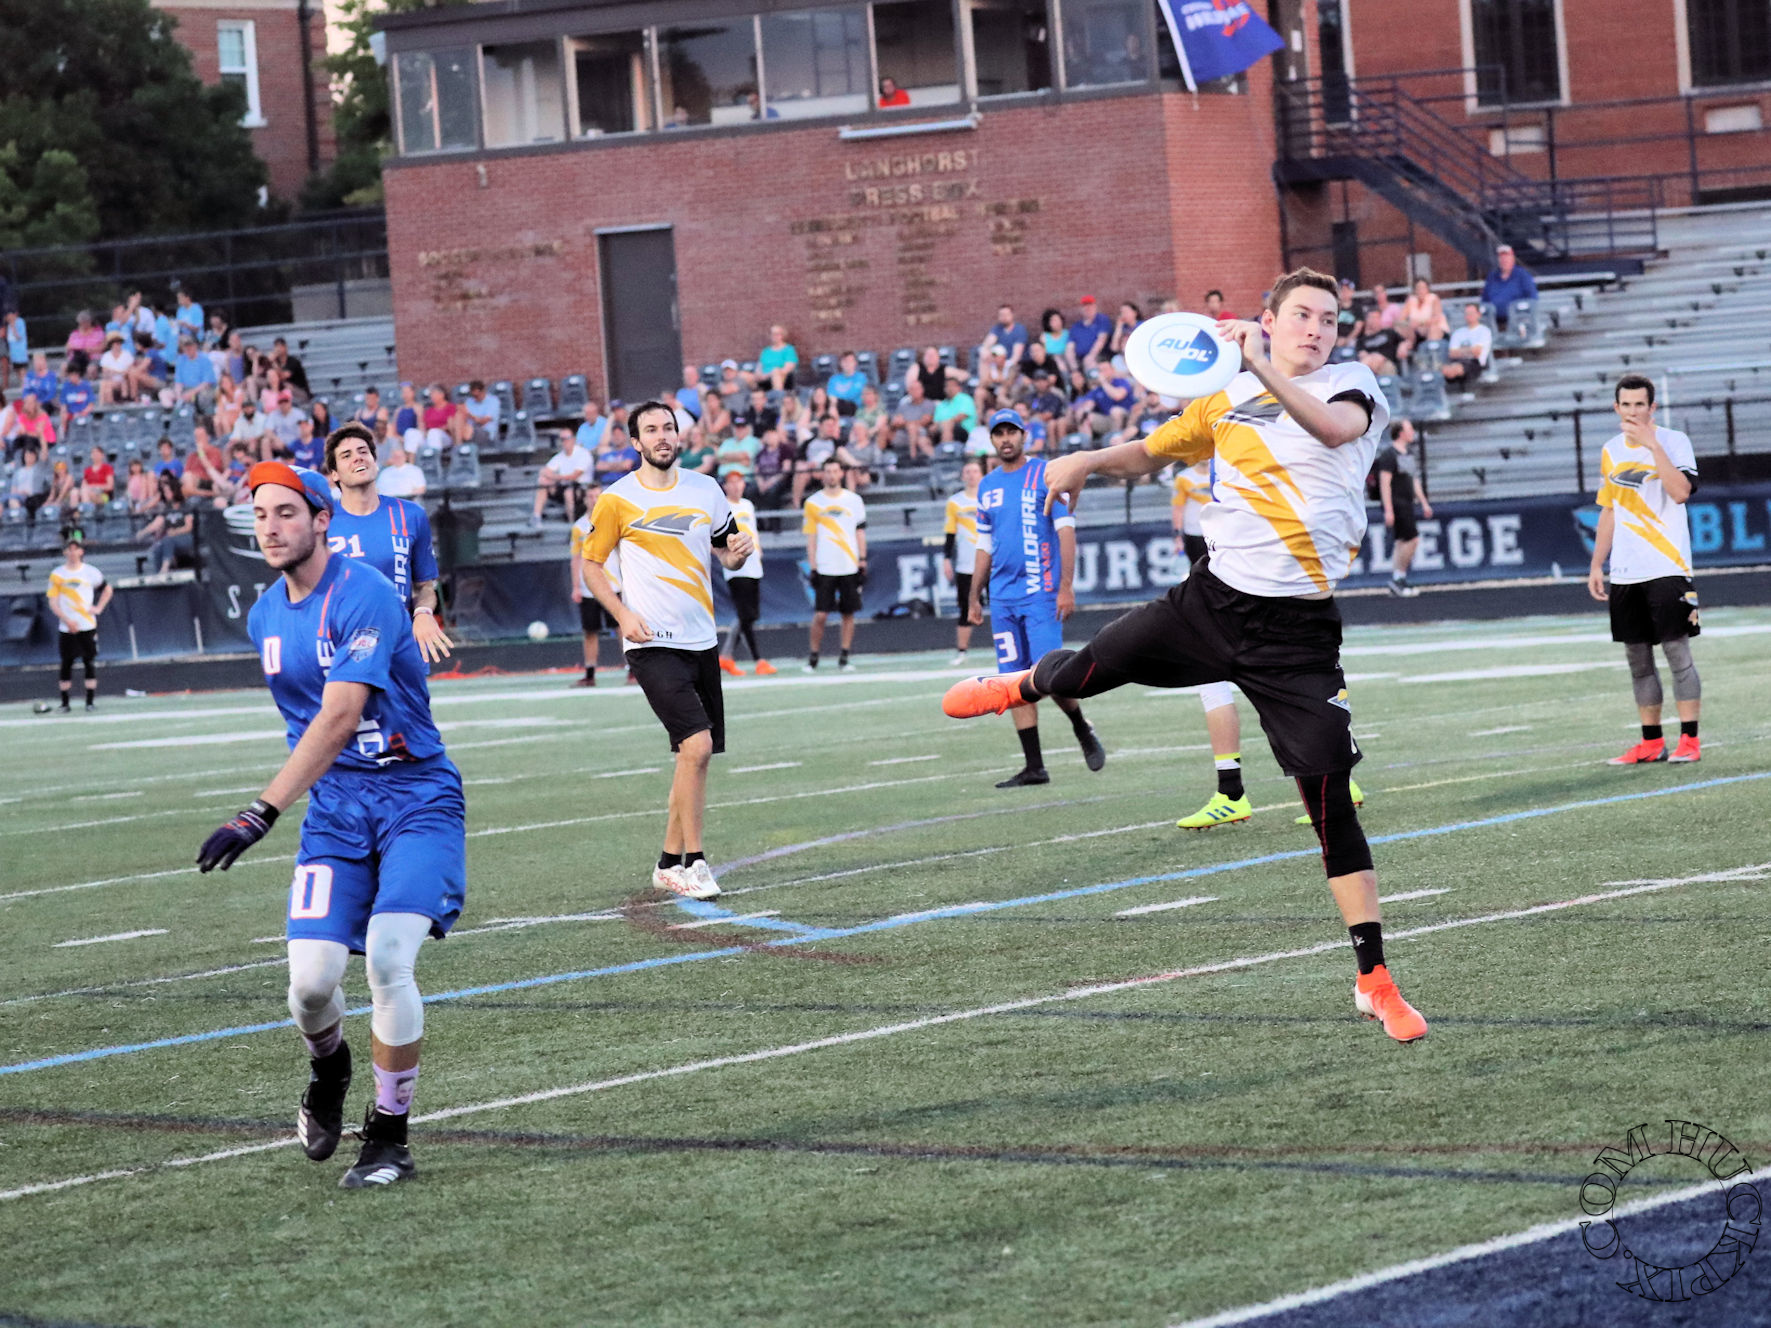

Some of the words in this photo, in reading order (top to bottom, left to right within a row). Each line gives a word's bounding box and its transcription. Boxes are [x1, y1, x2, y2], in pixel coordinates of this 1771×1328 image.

[845, 149, 980, 181] LANGHORST
[981, 488, 1004, 511] 63
[1021, 489, 1042, 595] WILDFIRE
[1688, 500, 1771, 553] BL
[327, 534, 365, 558] 21
